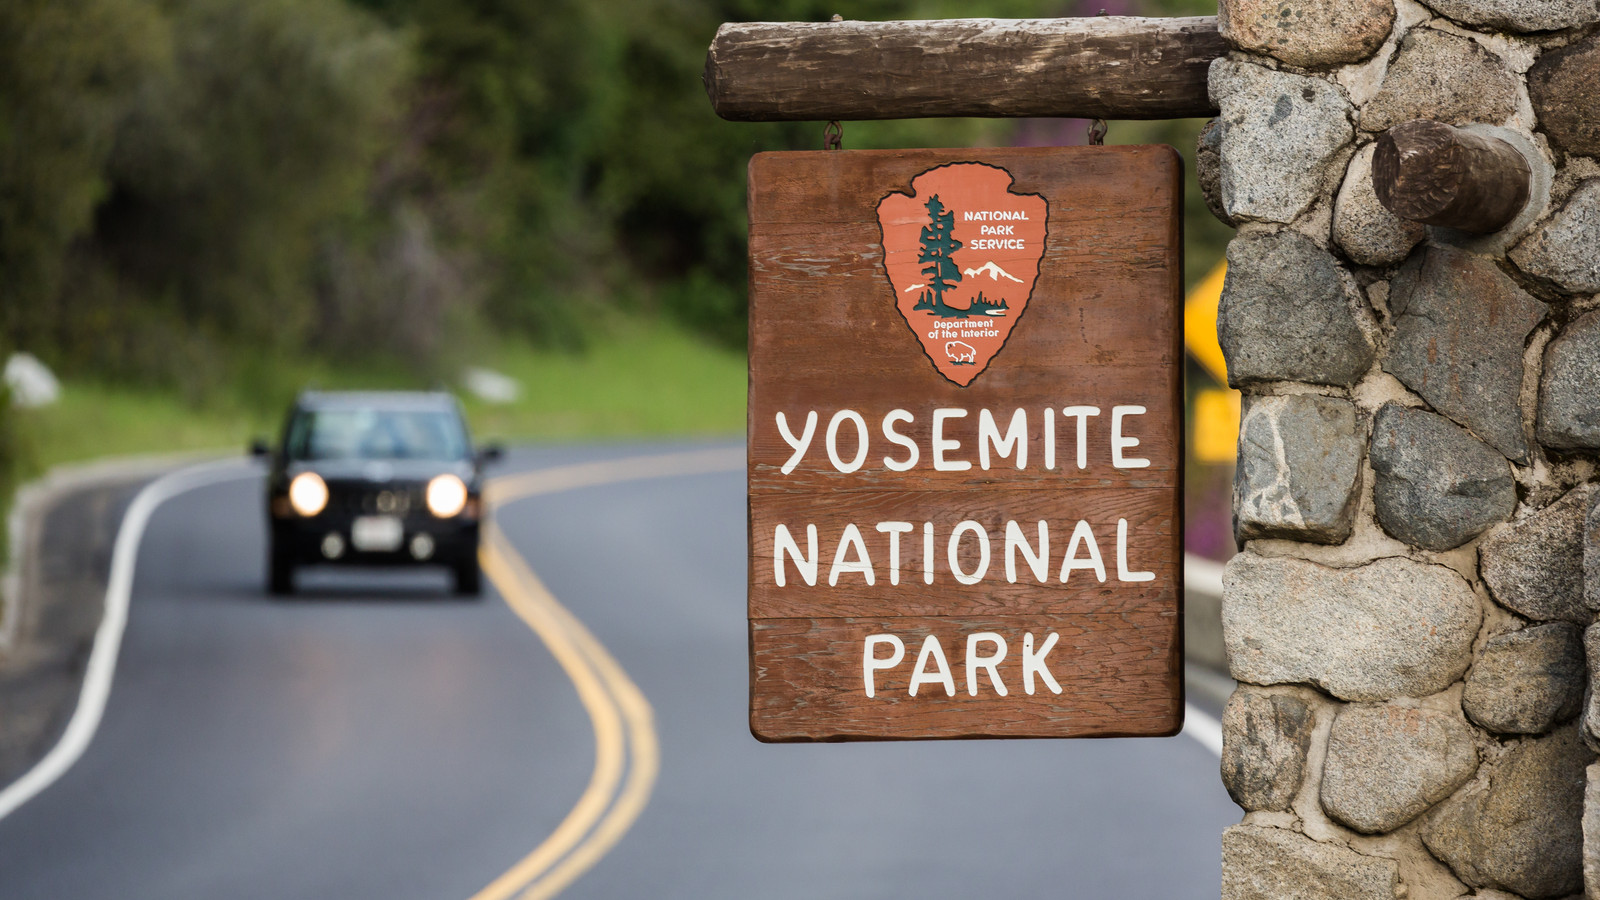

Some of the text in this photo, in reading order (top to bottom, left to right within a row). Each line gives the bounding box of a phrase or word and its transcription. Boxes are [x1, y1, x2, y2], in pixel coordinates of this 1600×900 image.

[964, 210, 1029, 221] NATIONAL
[980, 225, 1014, 235] PARK
[970, 239, 1025, 249] SERVICE
[934, 319, 994, 331] Department
[928, 329, 1000, 340] of the Interior
[775, 405, 1151, 475] YOSEMITE
[773, 518, 1156, 587] NATIONAL
[863, 632, 1063, 698] PARK
